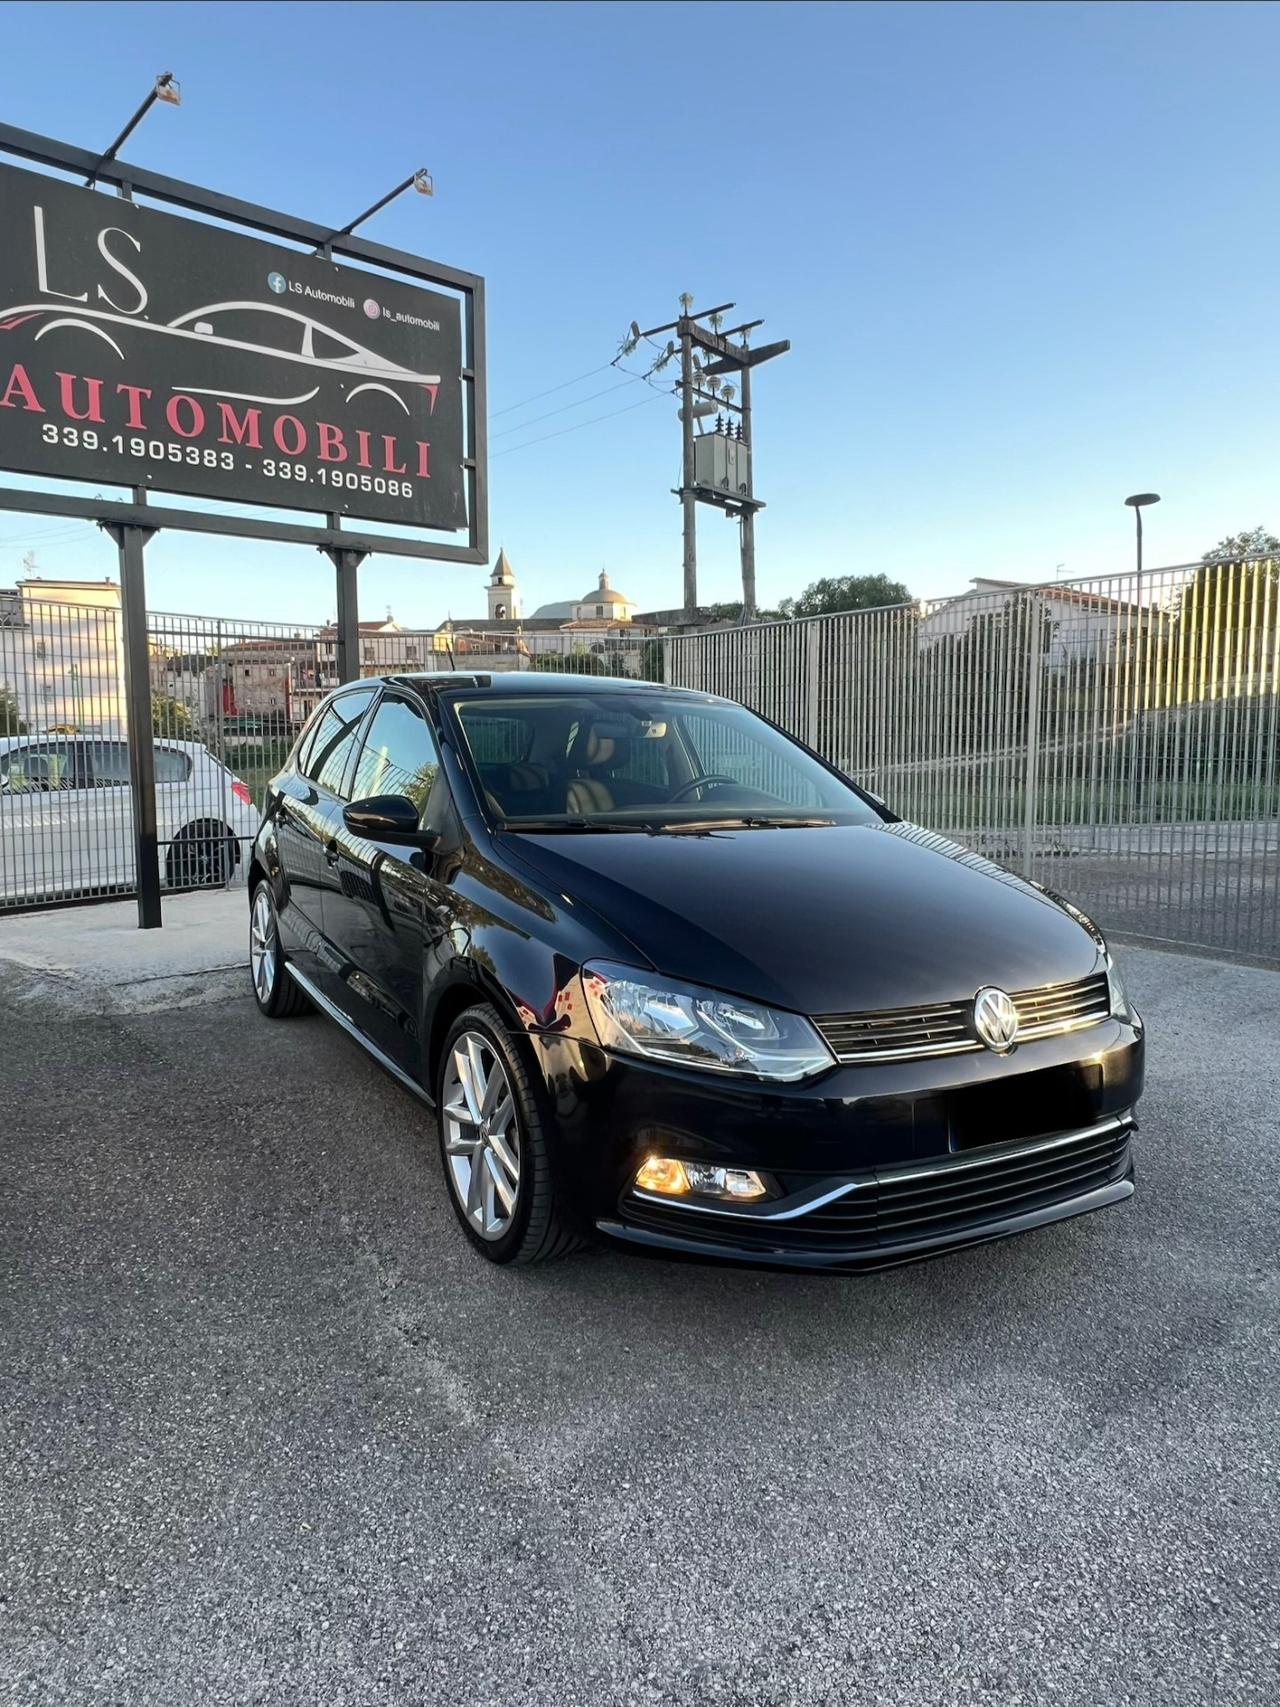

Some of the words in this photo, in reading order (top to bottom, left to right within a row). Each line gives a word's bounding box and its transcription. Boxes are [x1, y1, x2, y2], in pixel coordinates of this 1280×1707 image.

[34, 206, 148, 314] LS
[288, 280, 303, 294] LS
[304, 286, 355, 308] Automobili
[382, 307, 440, 331] ls_automobili
[0, 363, 431, 478] AUTOMOBILI
[42, 423, 235, 471] 339.1905383
[262, 459, 413, 498] 339.1905086
